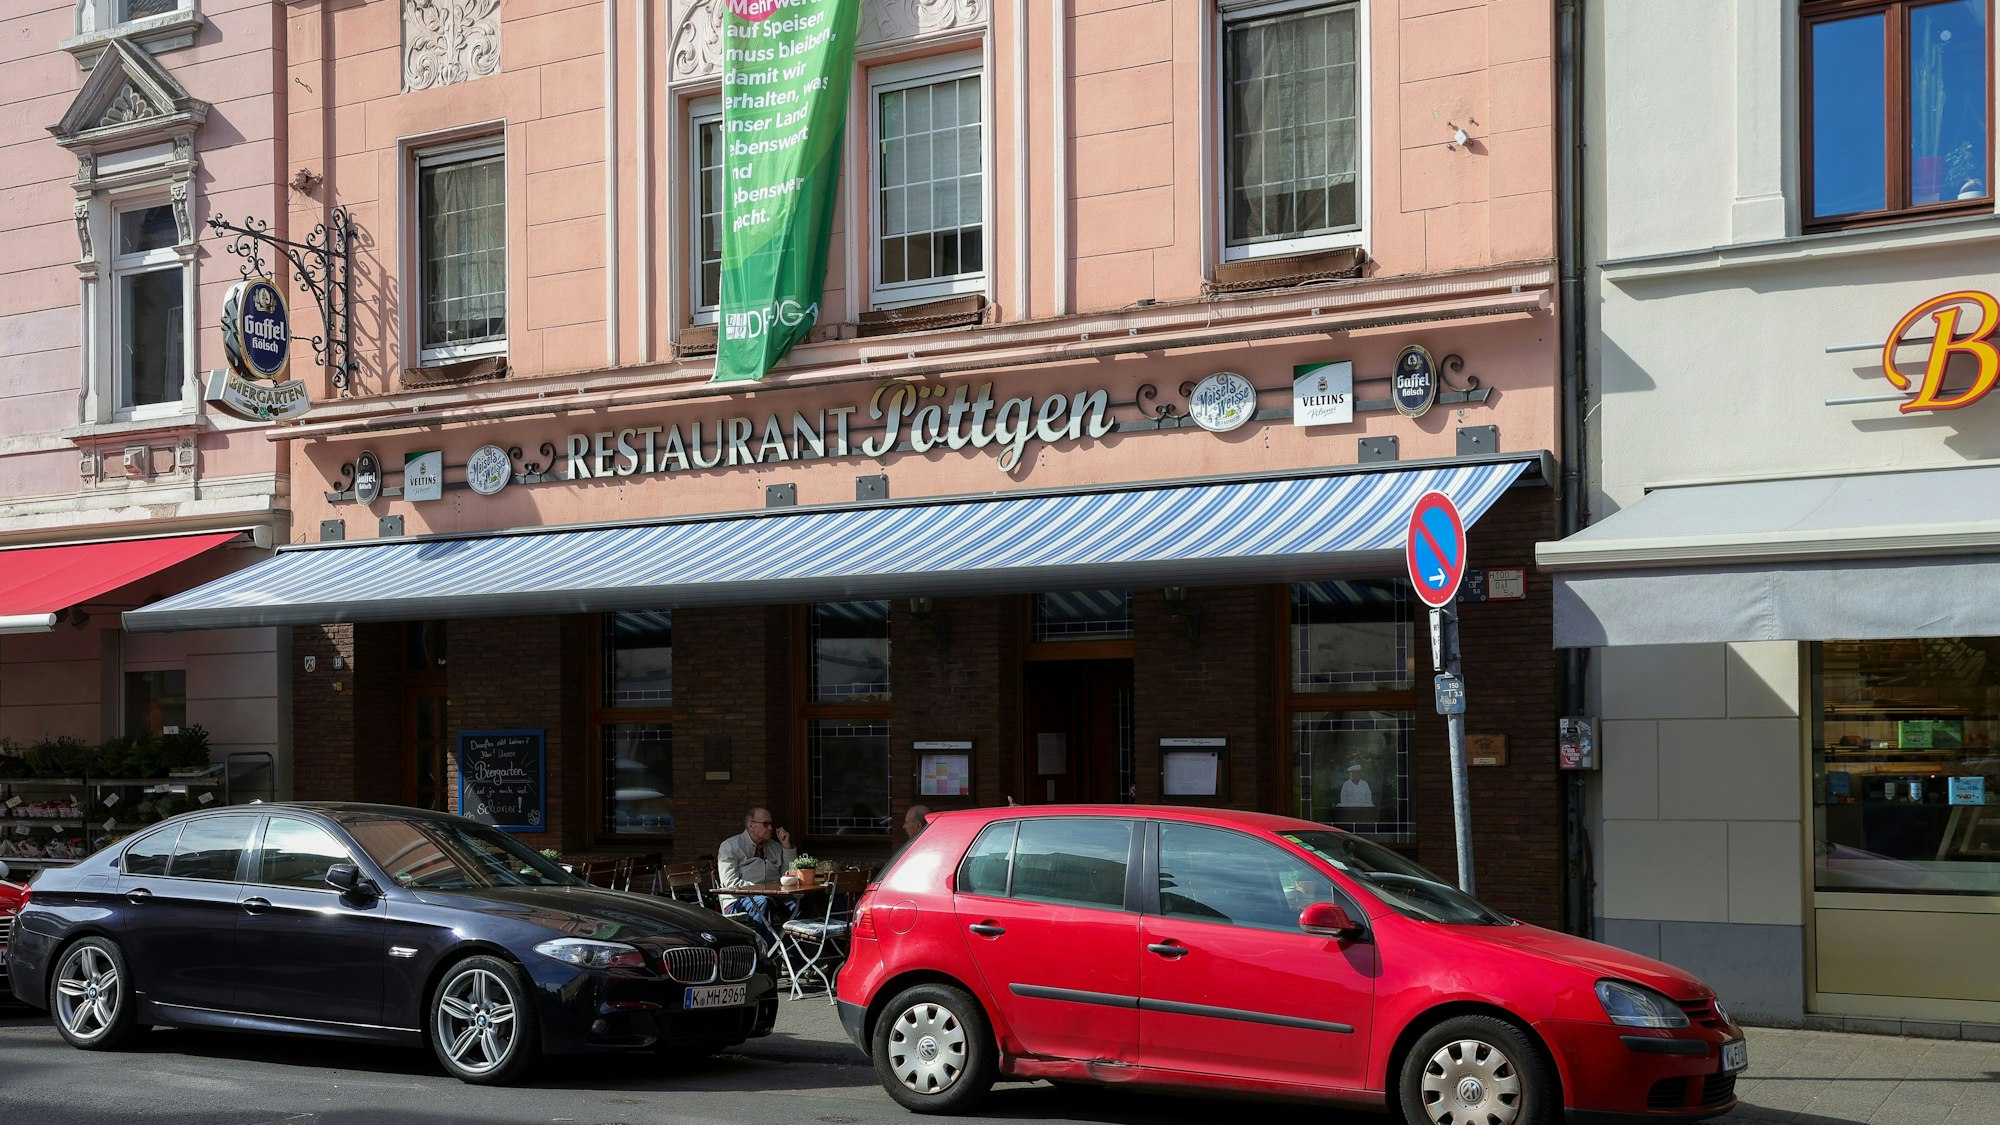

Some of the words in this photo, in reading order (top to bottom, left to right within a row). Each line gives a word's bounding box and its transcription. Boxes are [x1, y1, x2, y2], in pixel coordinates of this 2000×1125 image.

[727, 22, 760, 38] auf
[763, 10, 824, 39] Speisen
[726, 47, 774, 62] muss
[779, 27, 836, 58] bleiben,
[725, 68, 779, 86] damit
[783, 61, 806, 78] wir
[725, 90, 799, 110] erhalten,
[804, 76, 828, 96] was
[776, 101, 808, 128] Land
[244, 315, 287, 341] Gaffel
[252, 337, 279, 354] Kölsch
[229, 376, 305, 405] BIERGARTEN
[1397, 372, 1431, 389] Gaffel
[1402, 388, 1424, 397] Kölsch
[1302, 392, 1344, 407] VELTINS
[567, 405, 857, 480] RESTAURANT
[862, 379, 1115, 473] Pöttgen
[357, 472, 376, 484] Gaffel
[410, 476, 436, 487] VELTINS
[475, 760, 527, 785] Biergarten
[692, 991, 700, 1006] K
